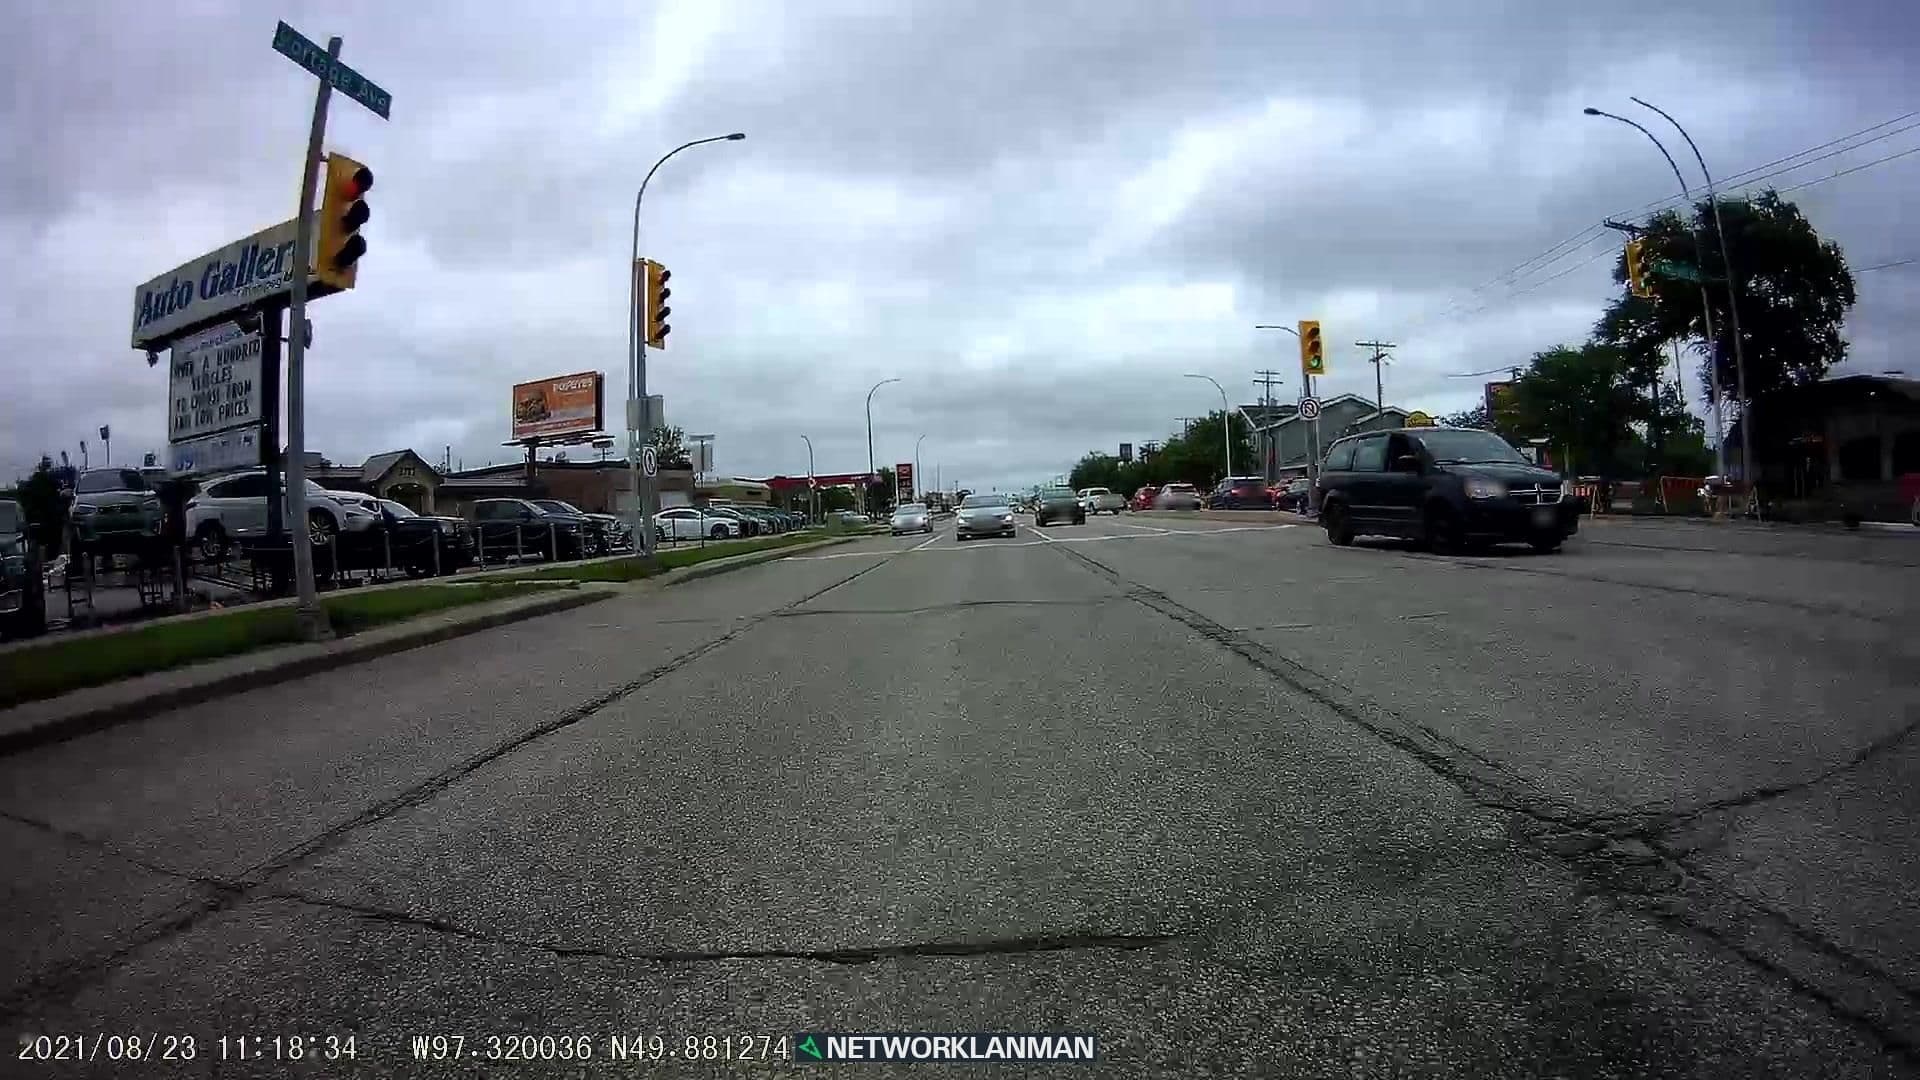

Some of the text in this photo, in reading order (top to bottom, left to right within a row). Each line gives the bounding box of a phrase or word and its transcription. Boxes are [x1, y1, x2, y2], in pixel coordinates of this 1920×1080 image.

[137, 276, 194, 329] Auto
[202, 354, 210, 371] A
[216, 339, 261, 366] HUNDRED
[218, 398, 250, 422] PRICES
